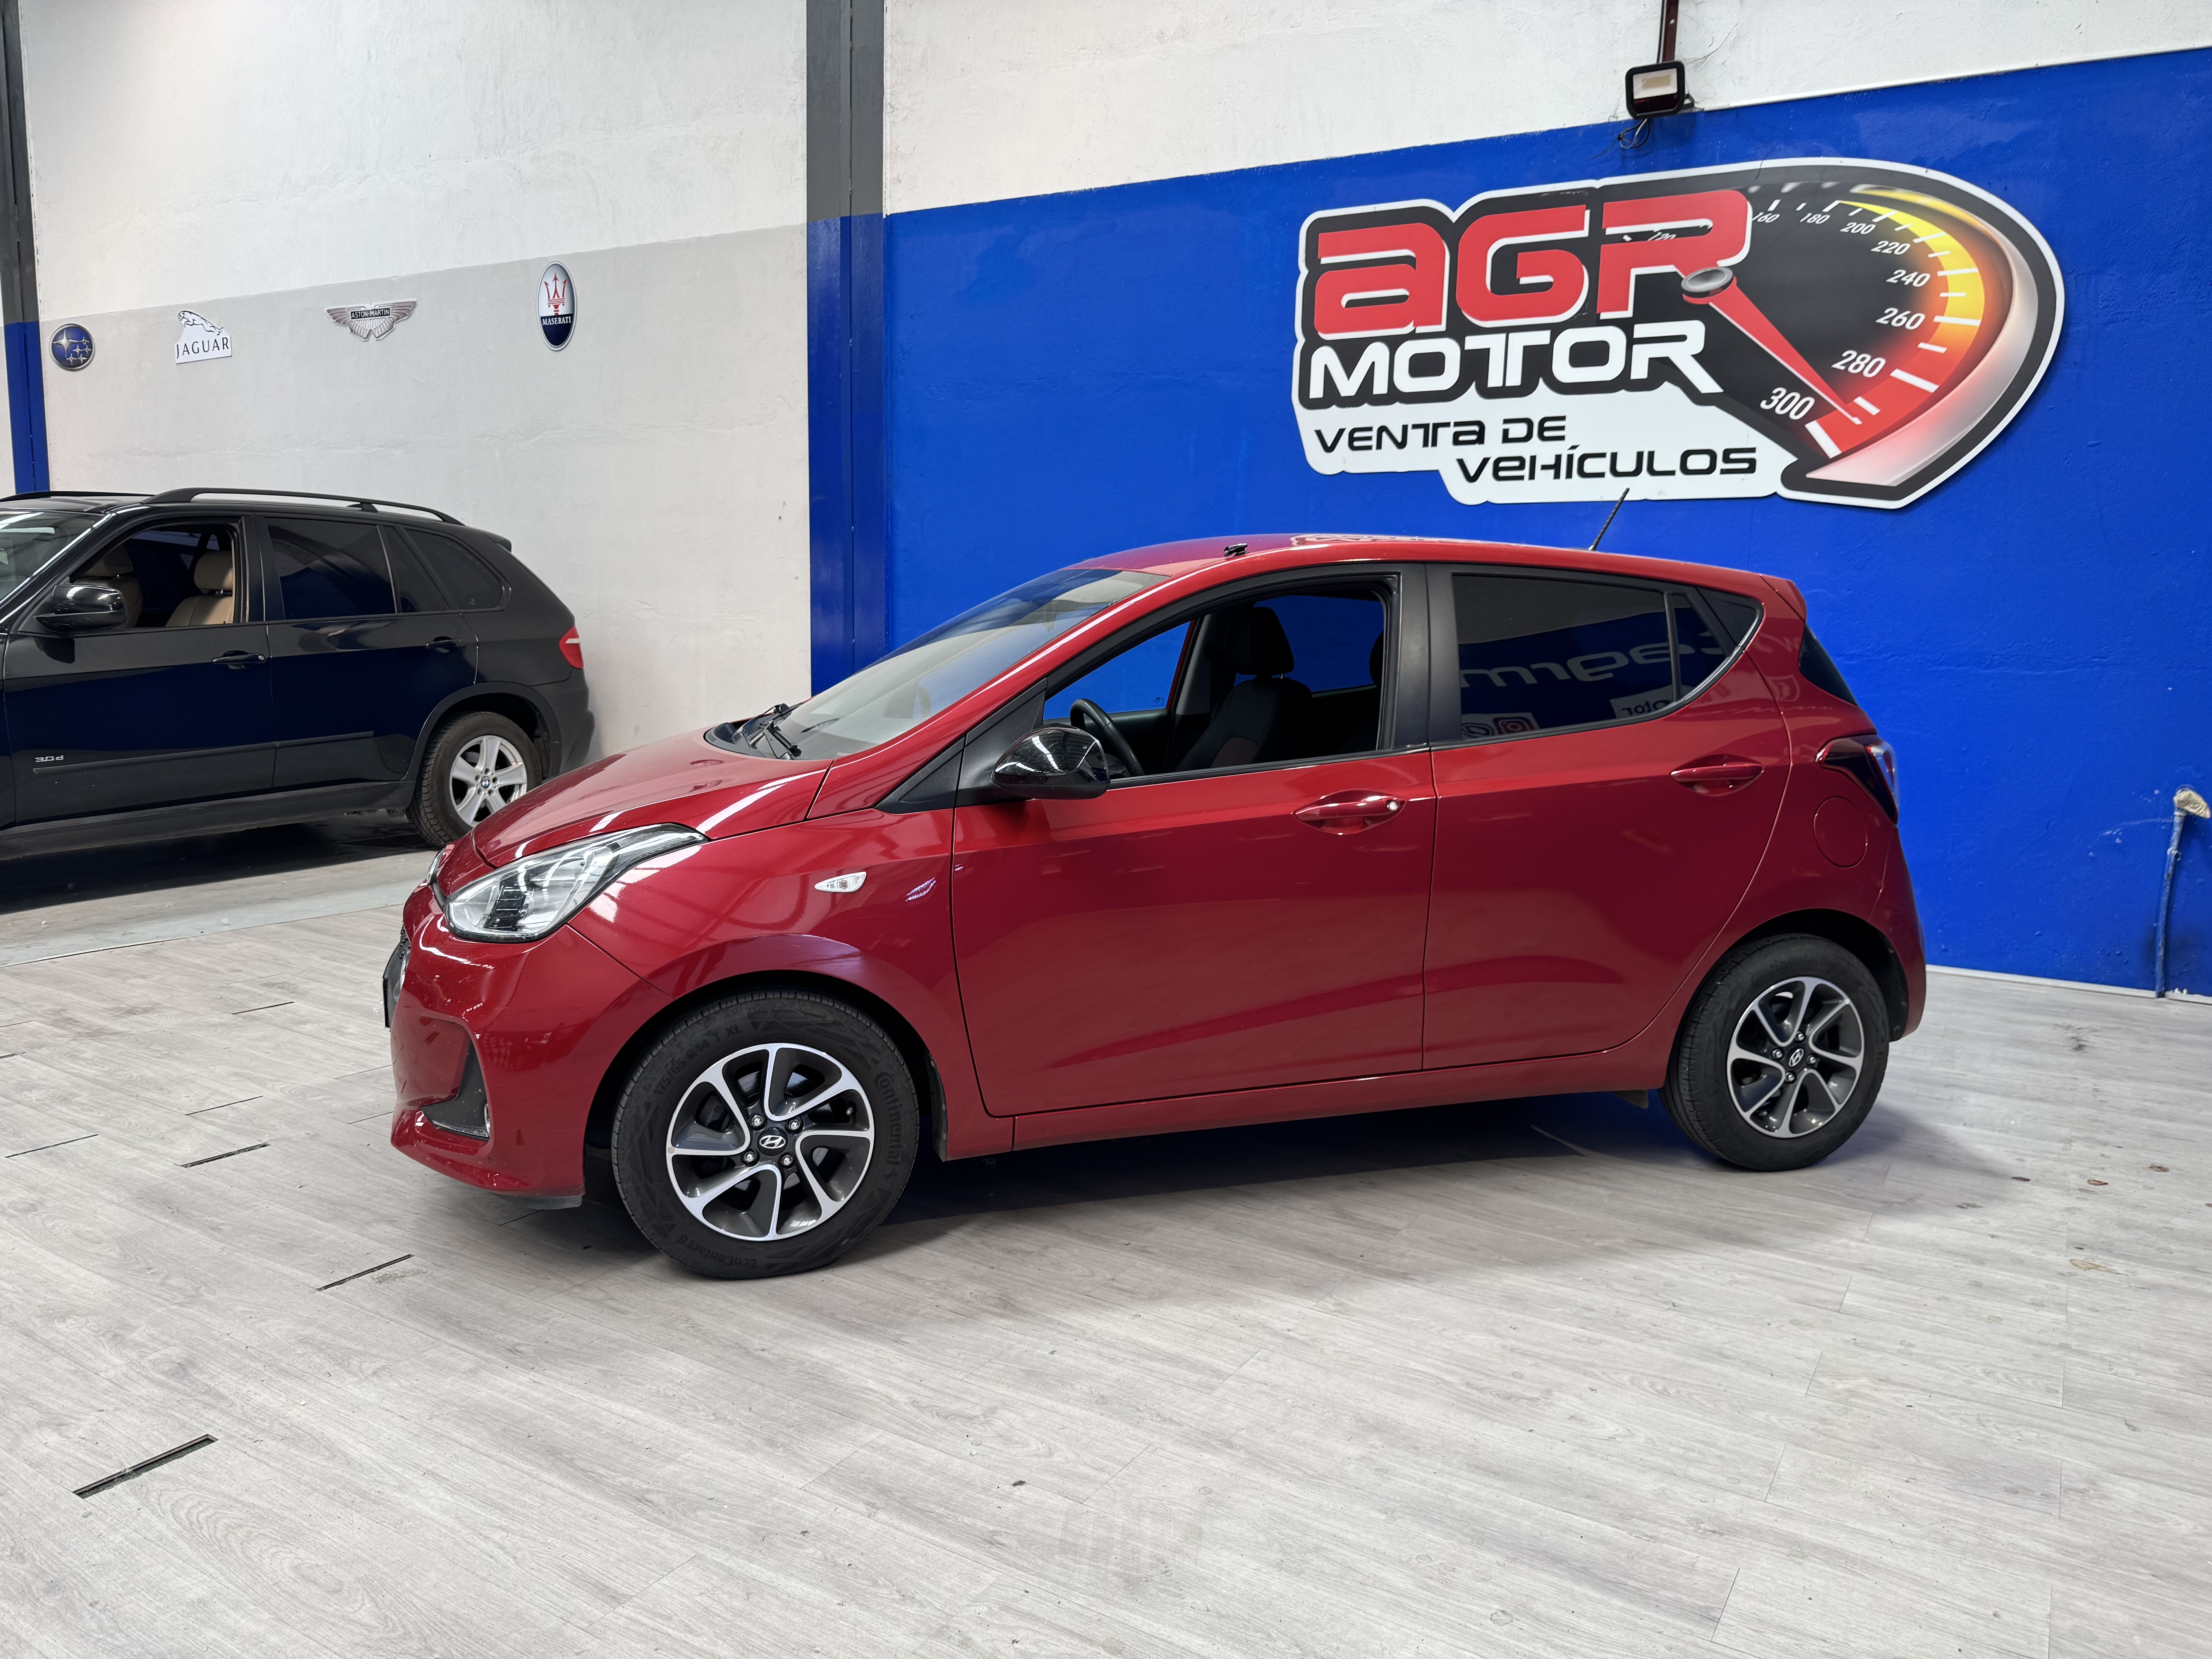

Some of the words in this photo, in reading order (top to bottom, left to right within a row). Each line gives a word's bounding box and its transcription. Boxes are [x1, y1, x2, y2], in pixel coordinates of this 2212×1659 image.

[1752, 212, 1780, 223] 160
[1800, 213, 1830, 224] 180
[1840, 222, 1876, 234] 200
[1870, 240, 1911, 256] 220
[1886, 269, 1931, 287] 240
[351, 309, 390, 318] ASTON-MARTIN
[543, 316, 571, 326] MASERATI
[1875, 308, 1925, 330] 260
[177, 337, 229, 359] JAGUAR
[1309, 319, 1724, 399] MOTOR
[1831, 350, 1886, 378] 280
[1760, 387, 1815, 421] 300
[1501, 415, 1566, 444] DE
[653, 1057, 686, 1095] 175/65
[725, 1024, 743, 1037] XL
[874, 1072, 903, 1166] Continental
[685, 1240, 757, 1270] EcoContact
